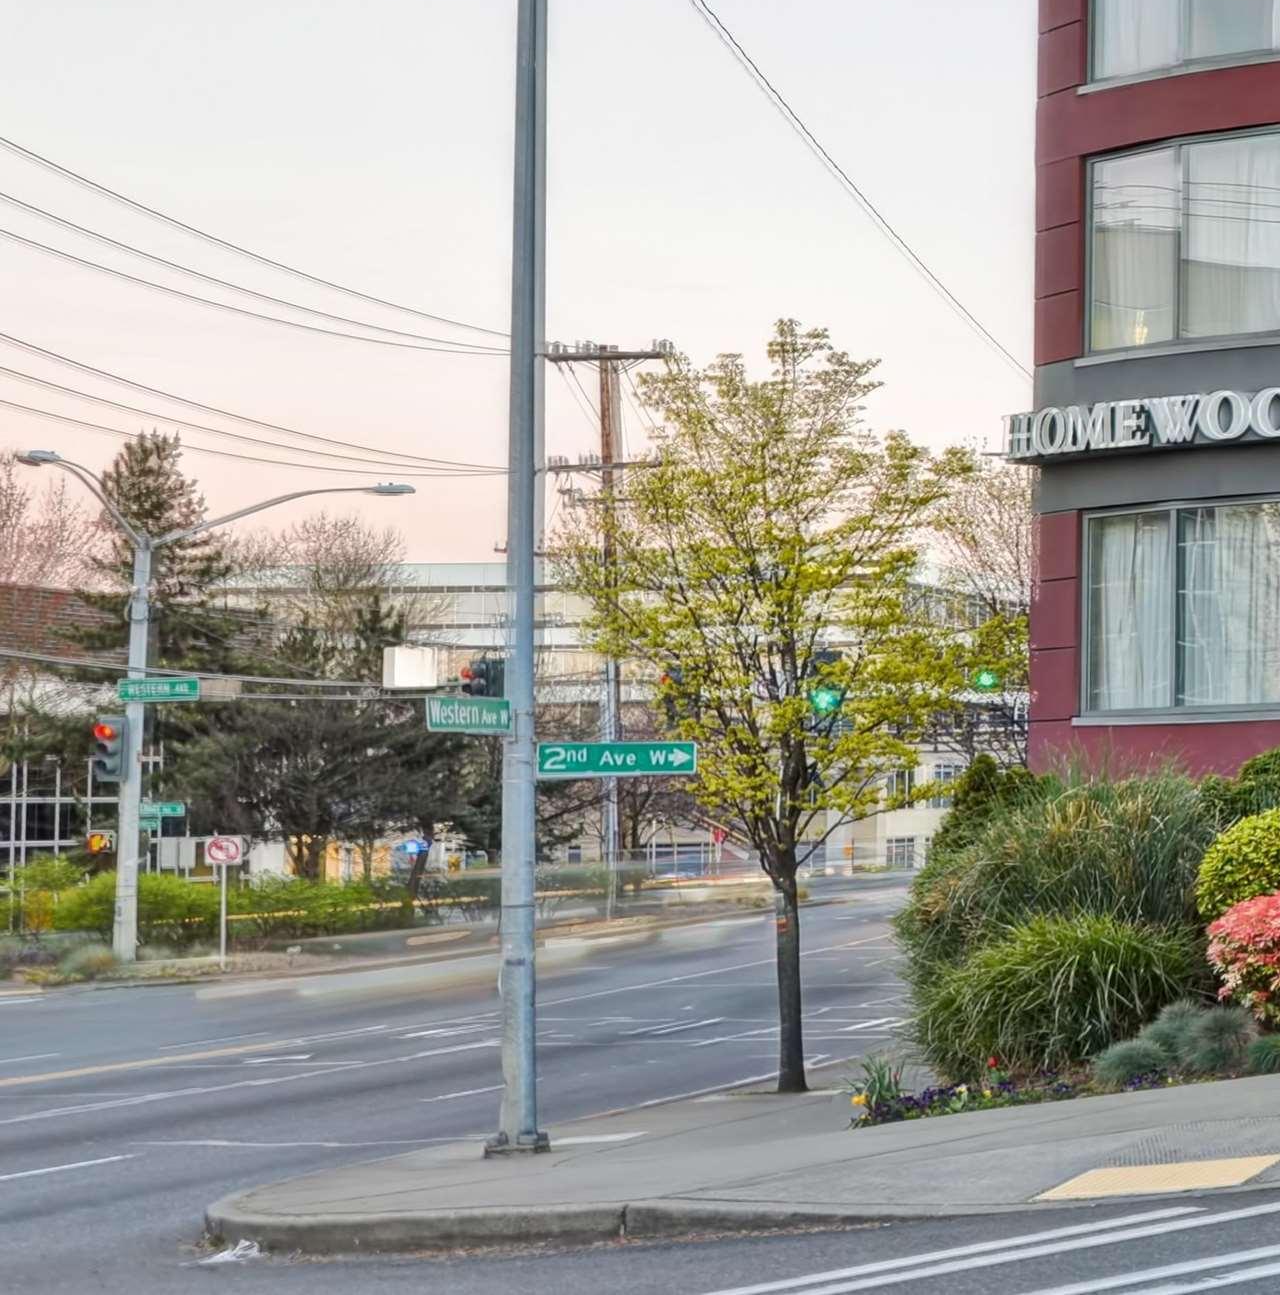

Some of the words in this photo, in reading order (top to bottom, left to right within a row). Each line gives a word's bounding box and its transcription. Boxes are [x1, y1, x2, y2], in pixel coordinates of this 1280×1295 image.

[430, 700, 479, 724] Western
[482, 708, 497, 725] Ave
[500, 709, 509, 726] W
[543, 746, 588, 770] 2nd
[600, 750, 636, 766] Ave
[650, 750, 667, 766] W
